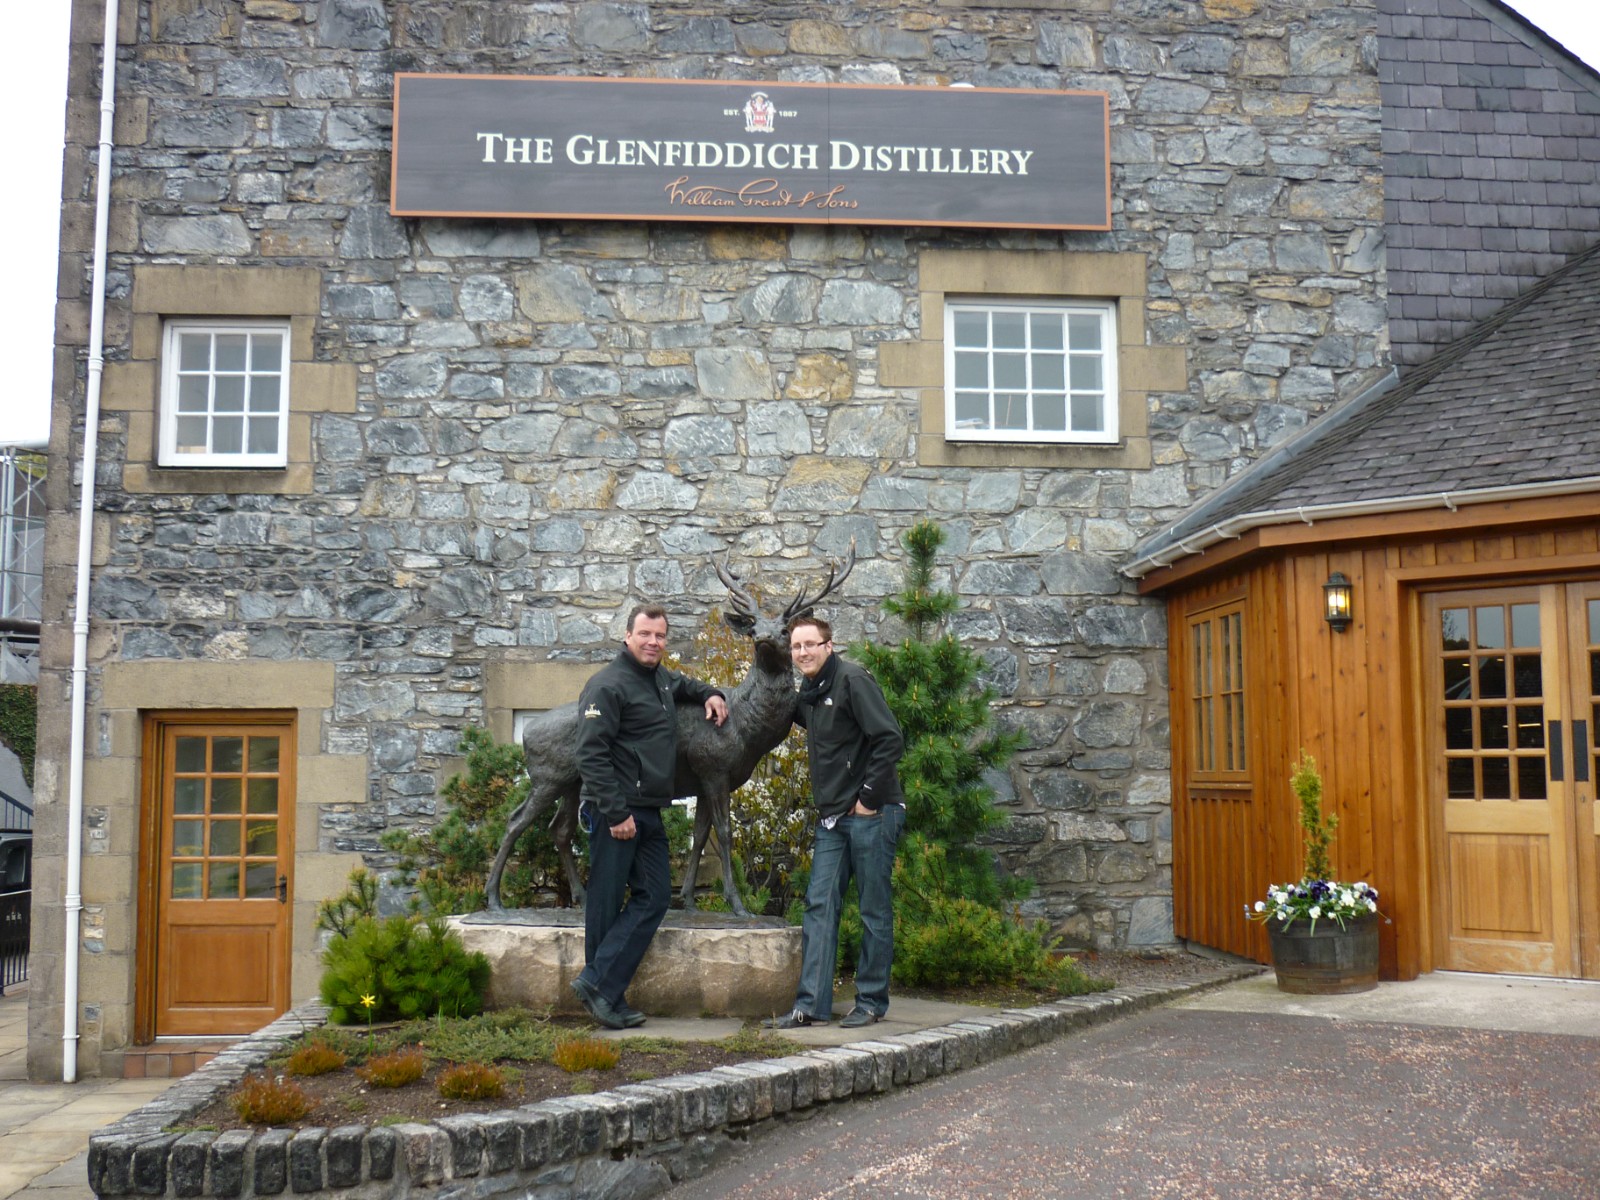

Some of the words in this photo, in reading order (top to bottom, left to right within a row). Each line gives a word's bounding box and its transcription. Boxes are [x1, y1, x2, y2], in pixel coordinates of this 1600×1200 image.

[723, 108, 740, 116] EST.
[476, 132, 553, 164] THE
[565, 134, 819, 170] GLENFIDDICH
[829, 140, 1034, 175] DISTILLERY
[664, 175, 737, 207] William
[738, 177, 794, 208] Grant
[797, 190, 816, 209] &
[816, 184, 859, 210] Sons
